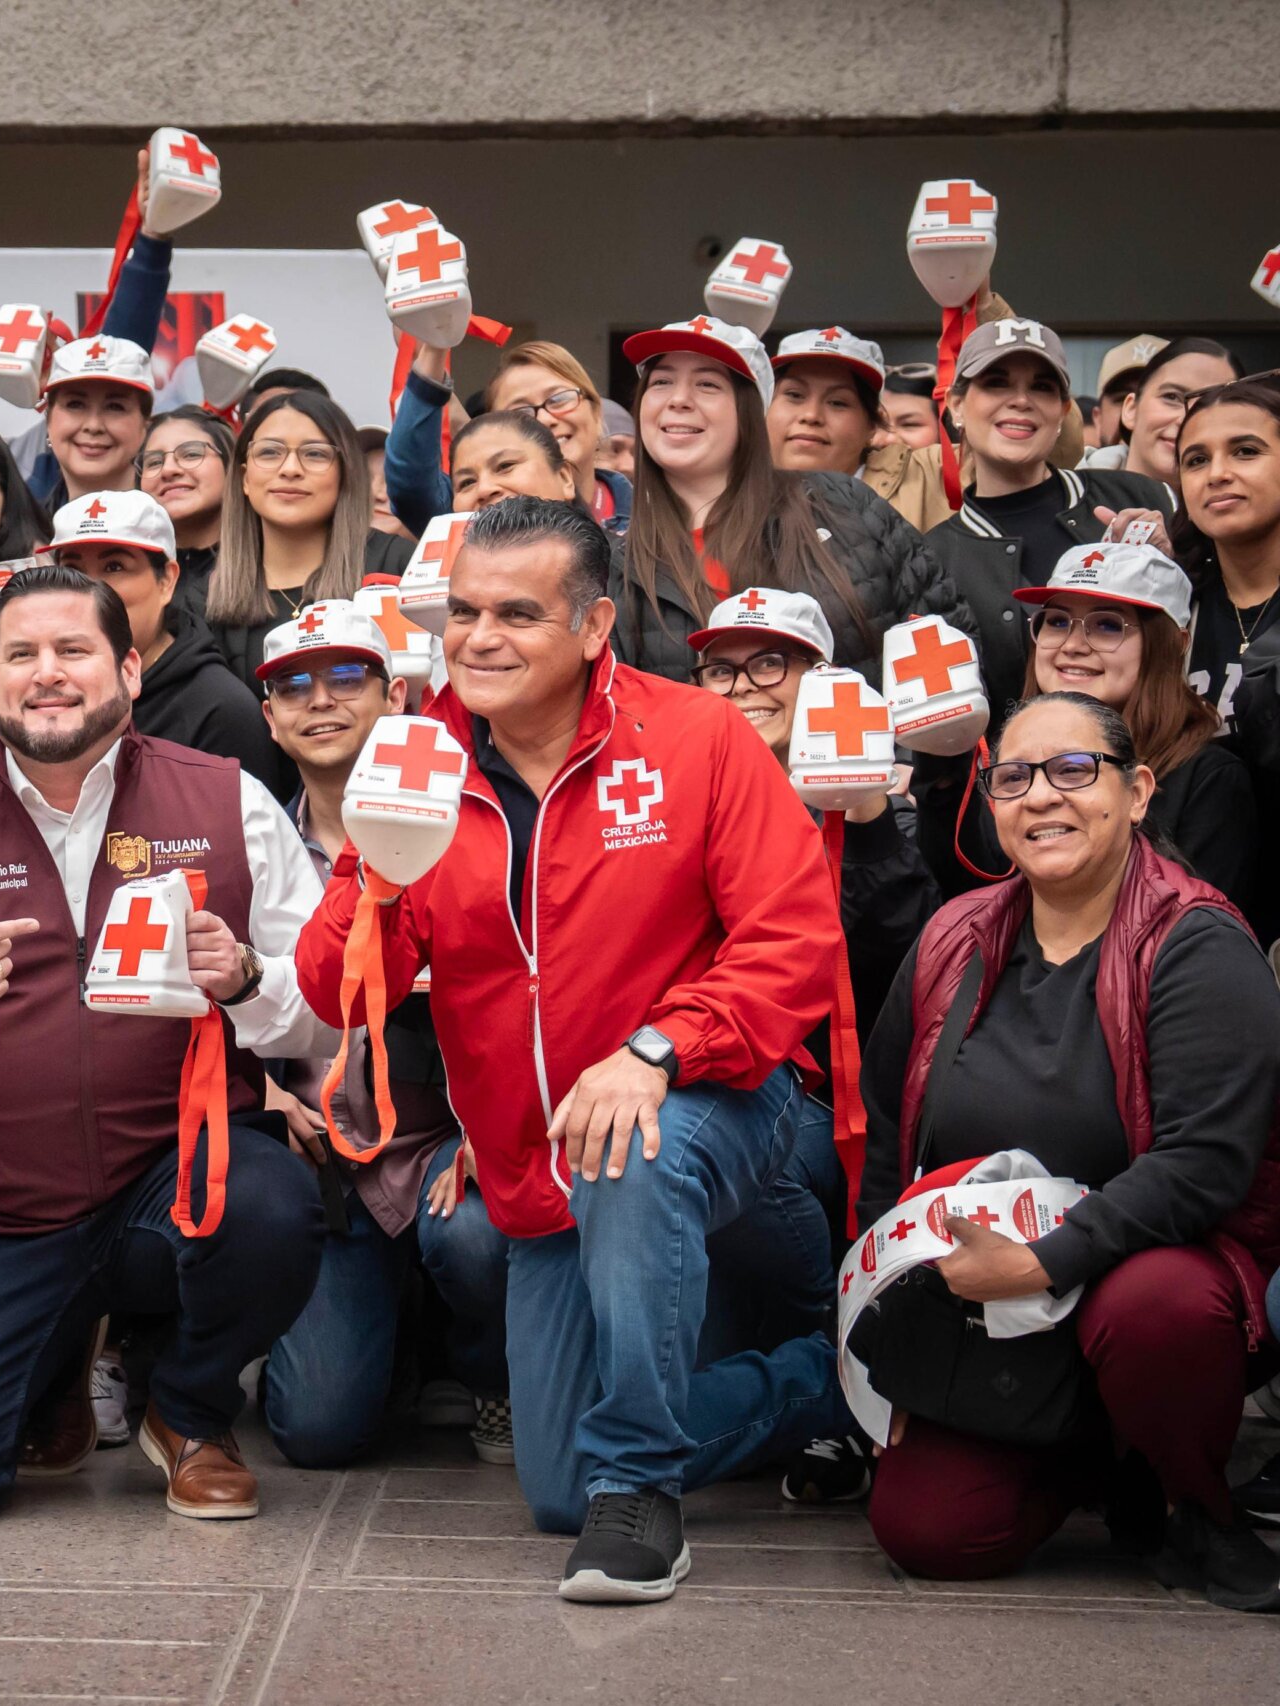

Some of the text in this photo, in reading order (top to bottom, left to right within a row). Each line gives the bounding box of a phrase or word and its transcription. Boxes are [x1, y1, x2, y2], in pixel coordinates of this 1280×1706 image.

[995, 318, 1046, 348] M
[601, 819, 666, 838] CRUZ ROJA
[152, 838, 211, 853] TIJUANA
[604, 832, 668, 850] MEXICANA
[9, 863, 27, 874] Ruiz
